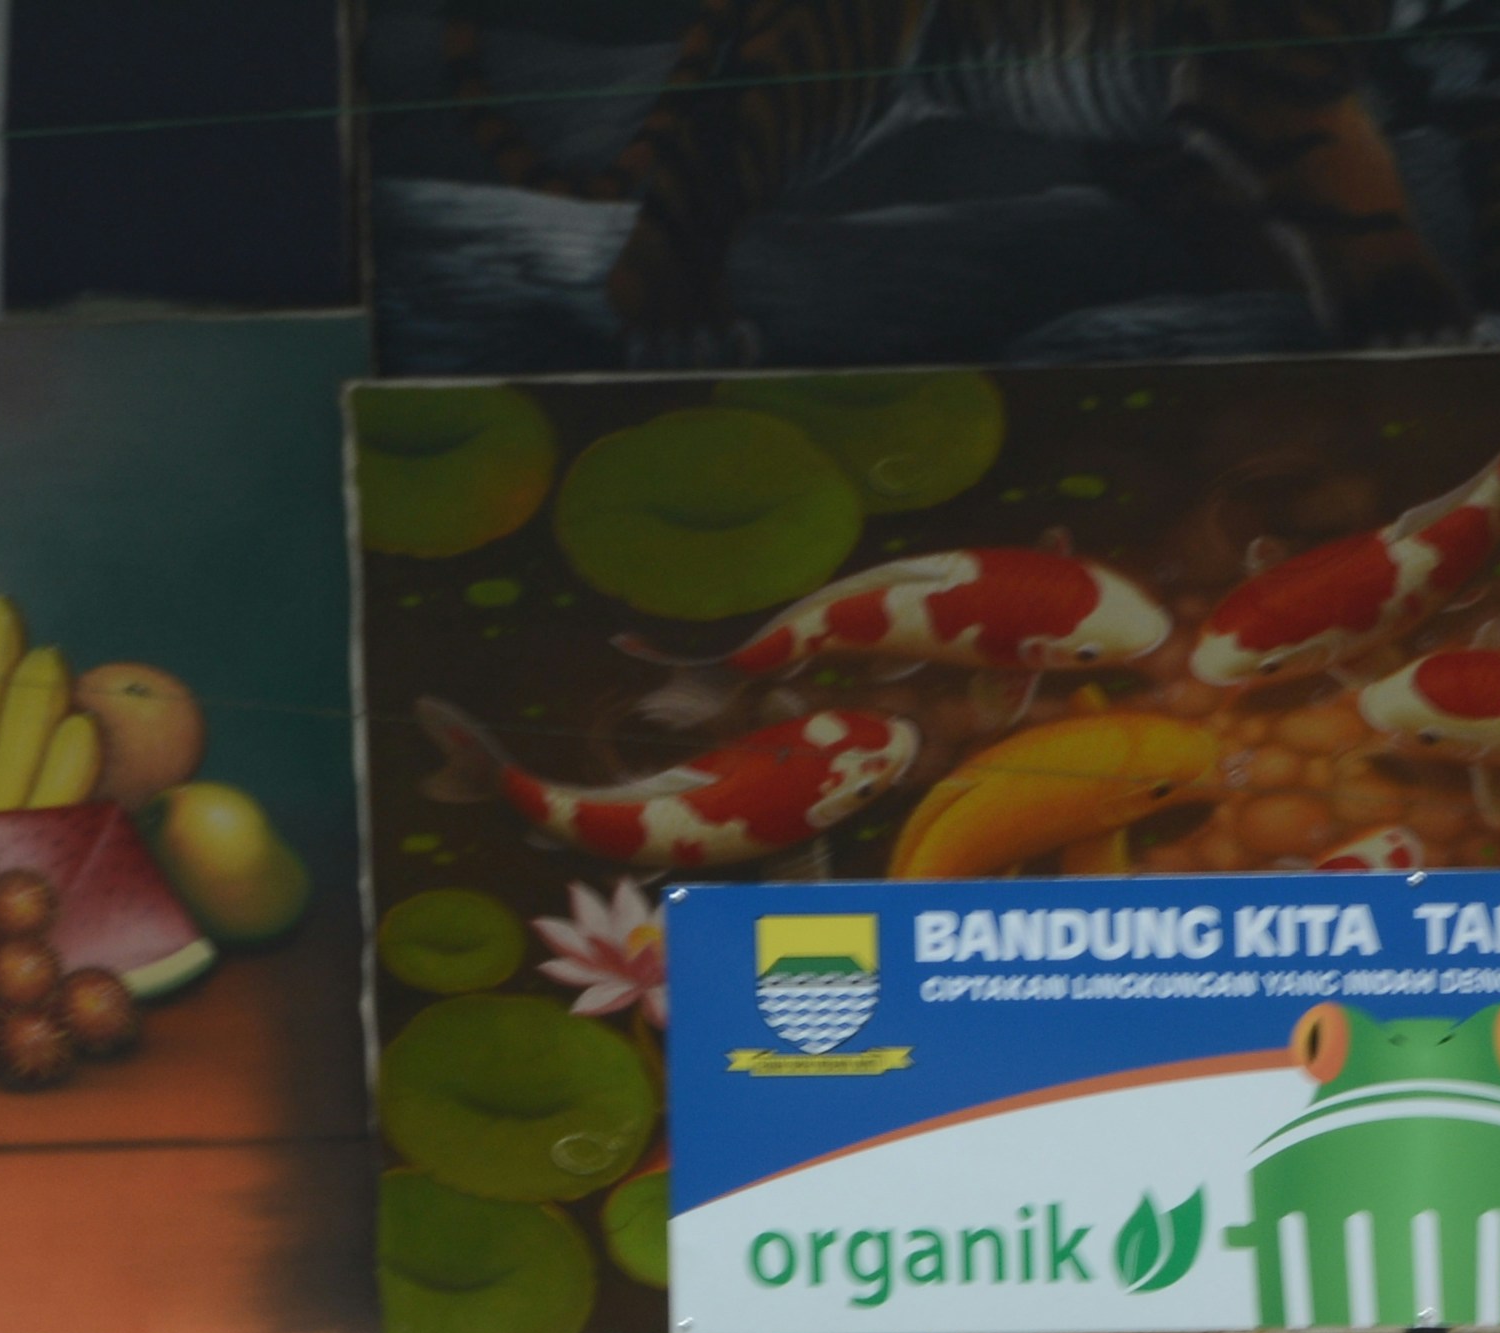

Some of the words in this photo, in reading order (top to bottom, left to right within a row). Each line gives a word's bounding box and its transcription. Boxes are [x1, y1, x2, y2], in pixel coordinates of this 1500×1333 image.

[914, 905, 1223, 963] BANDUNG
[1234, 904, 1383, 957] KITA
[921, 975, 1069, 1002] CIPTAKAN
[1071, 971, 1259, 999] LINGKUNGAN
[1262, 970, 1340, 997] YANG
[1343, 968, 1438, 995] INDAH
[746, 1202, 1096, 1308] organik
